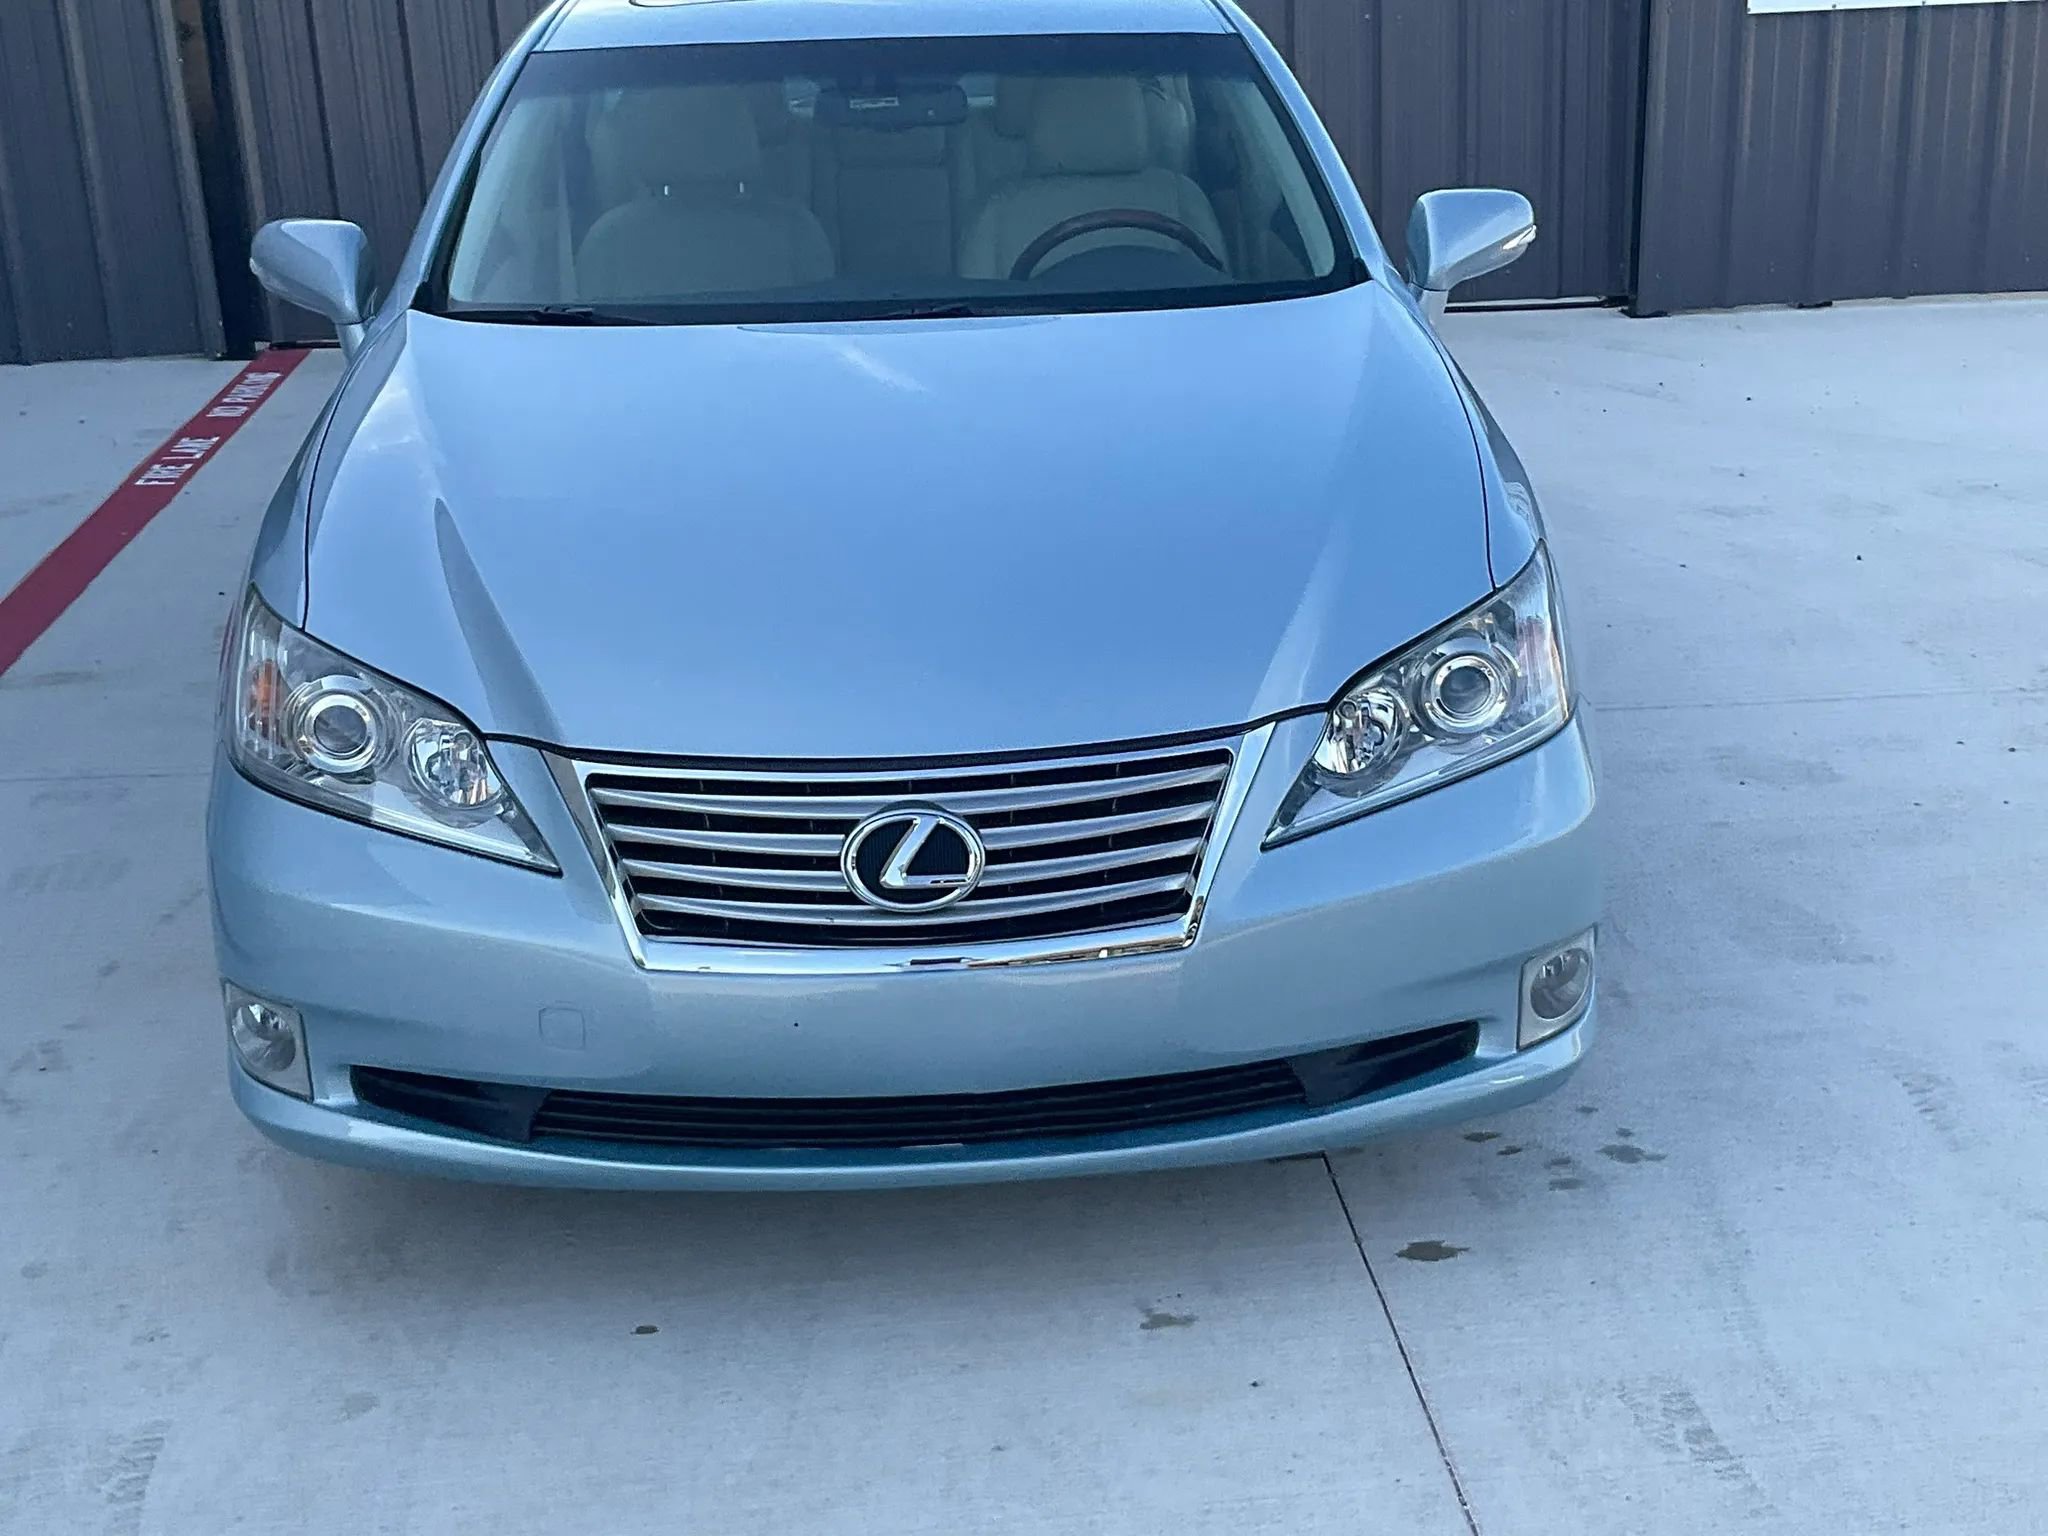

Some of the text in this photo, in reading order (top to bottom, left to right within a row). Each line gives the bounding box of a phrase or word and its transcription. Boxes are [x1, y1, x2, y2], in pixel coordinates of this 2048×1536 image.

[134, 371, 284, 485] FIRE LANE NO PARKING
